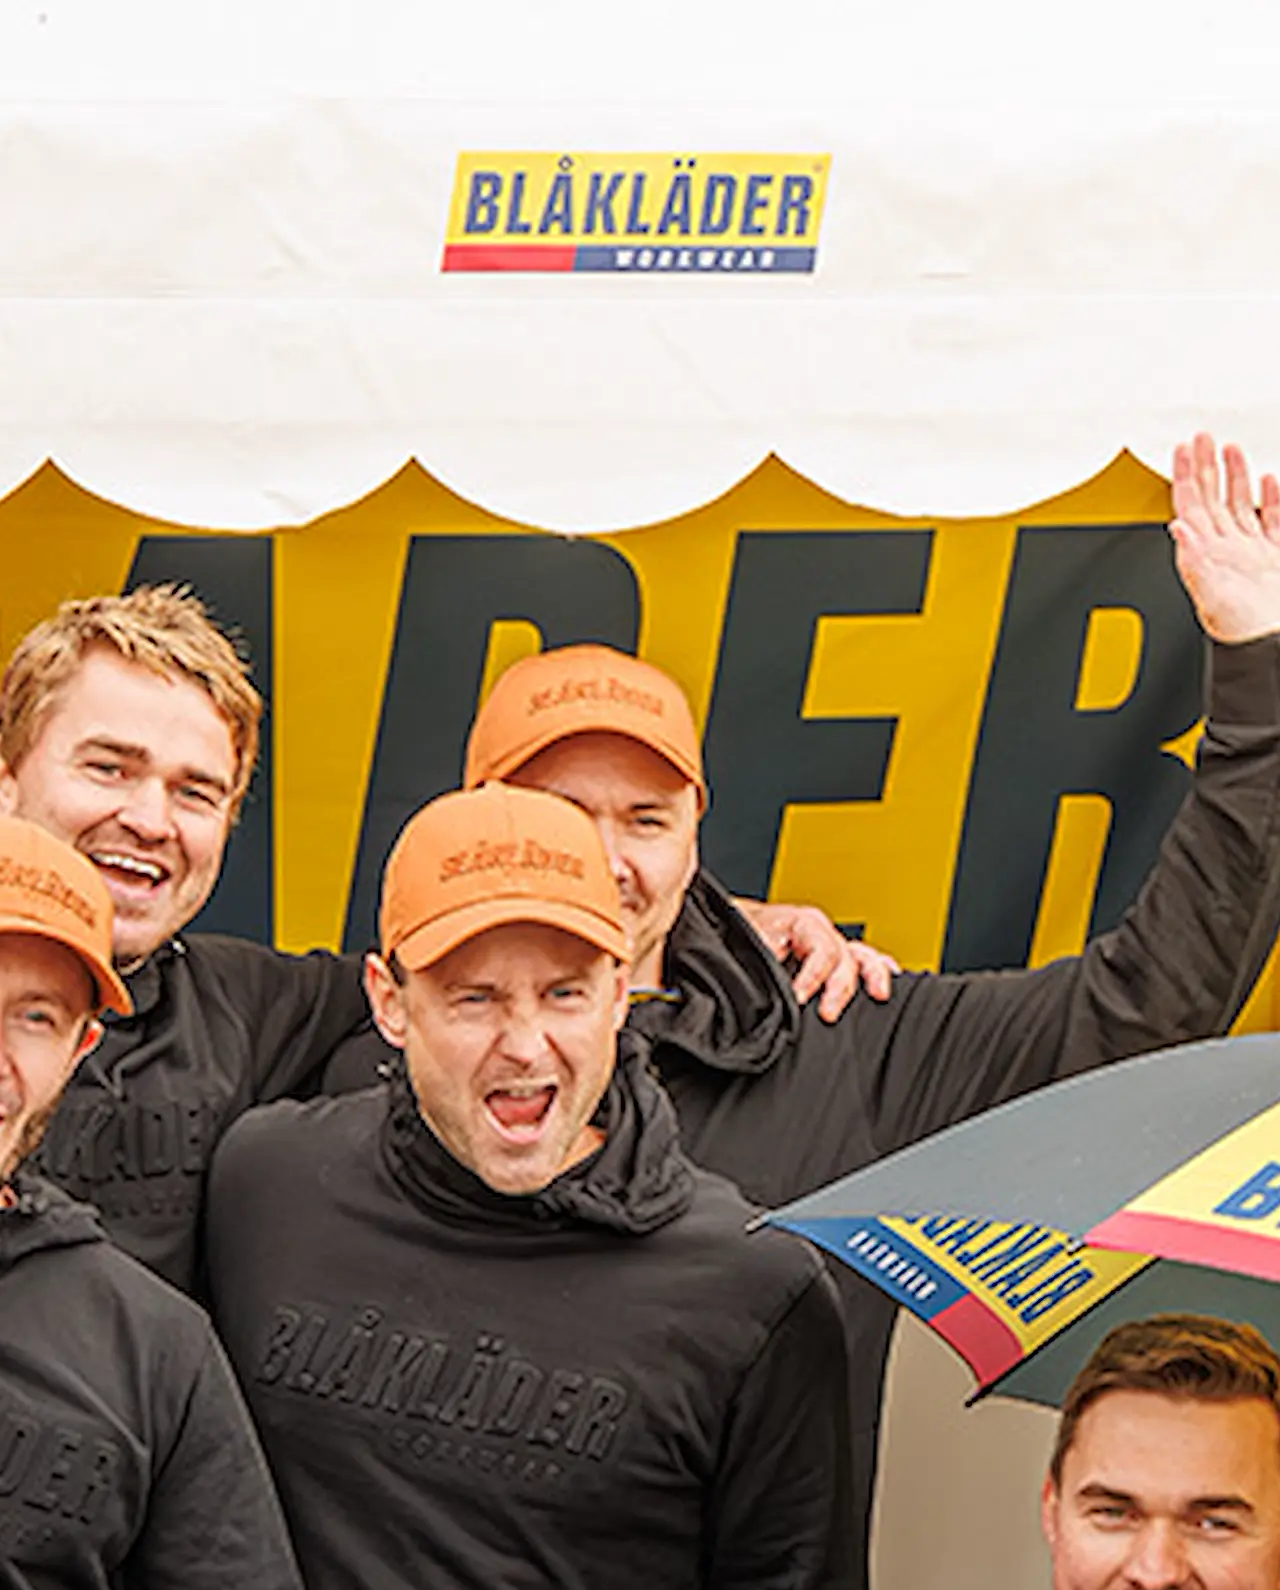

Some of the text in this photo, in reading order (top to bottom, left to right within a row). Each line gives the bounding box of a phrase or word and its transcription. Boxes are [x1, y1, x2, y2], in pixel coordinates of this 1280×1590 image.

[464, 155, 815, 237] BLÅKLÄDER
[615, 248, 776, 269] WORKWEAR
[257, 1307, 627, 1462] BLÅKLÄDER
